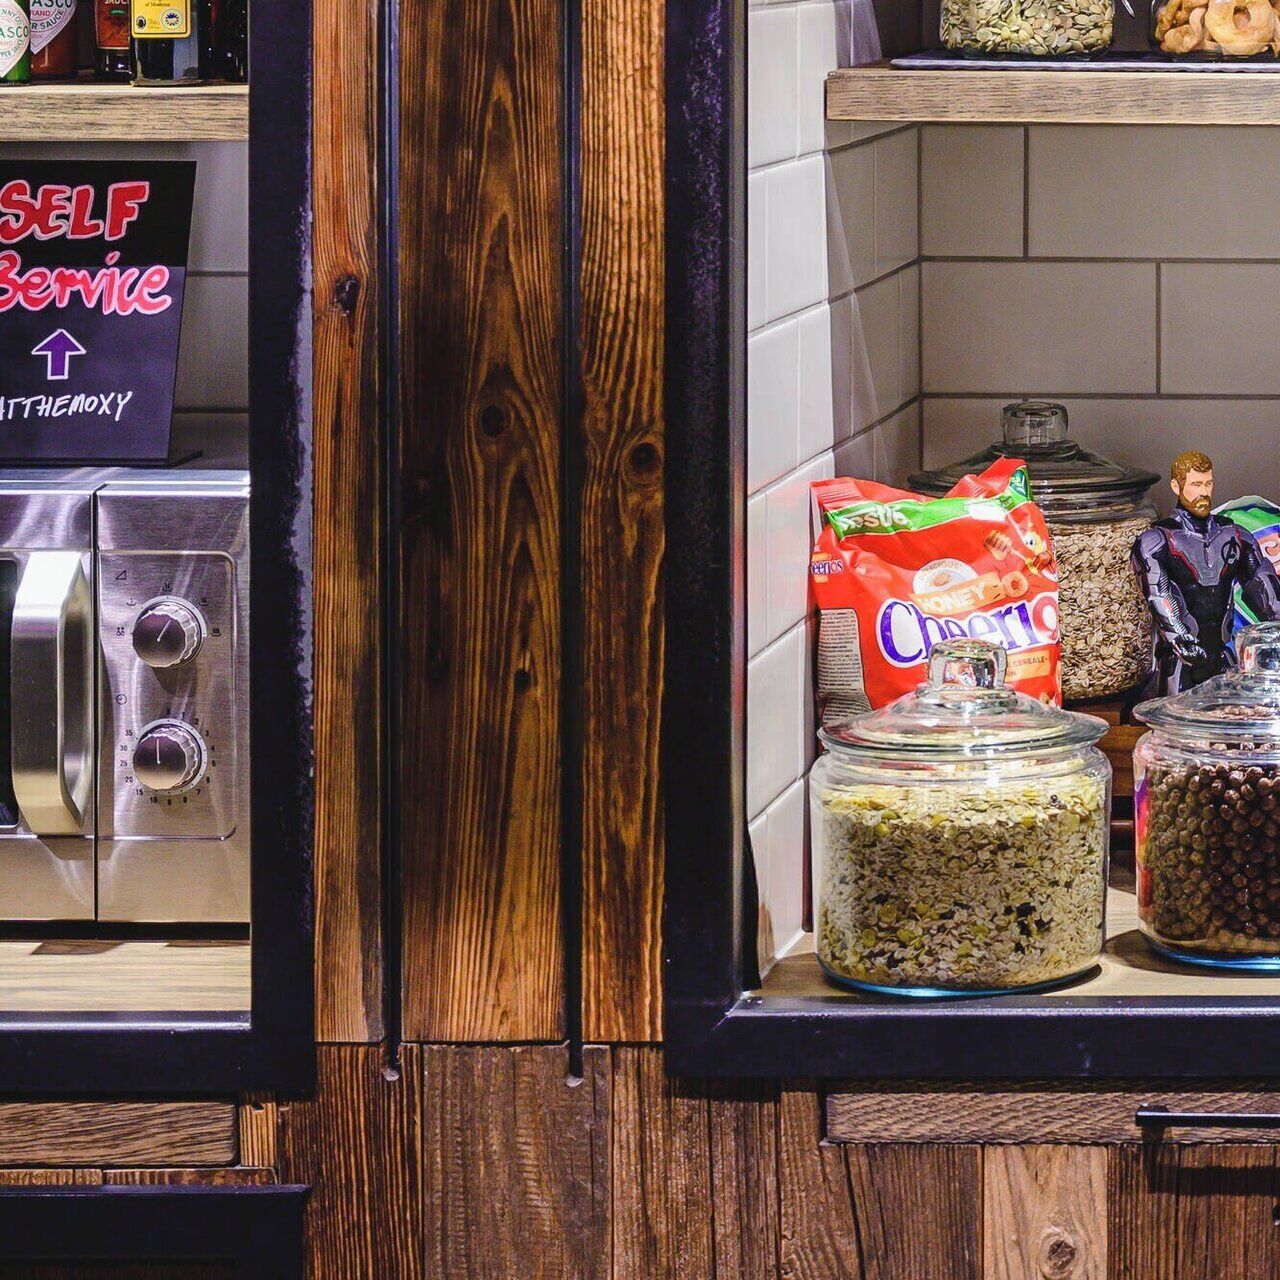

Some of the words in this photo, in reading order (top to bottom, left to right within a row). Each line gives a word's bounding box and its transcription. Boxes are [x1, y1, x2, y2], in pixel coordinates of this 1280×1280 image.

[0, 25, 29, 38] ASCO
[40, 8, 64, 30] SAUCE
[0, 180, 150, 244] SELF
[0, 250, 172, 315] Service
[812, 561, 843, 575] eerios
[880, 595, 1059, 664] Cheerio
